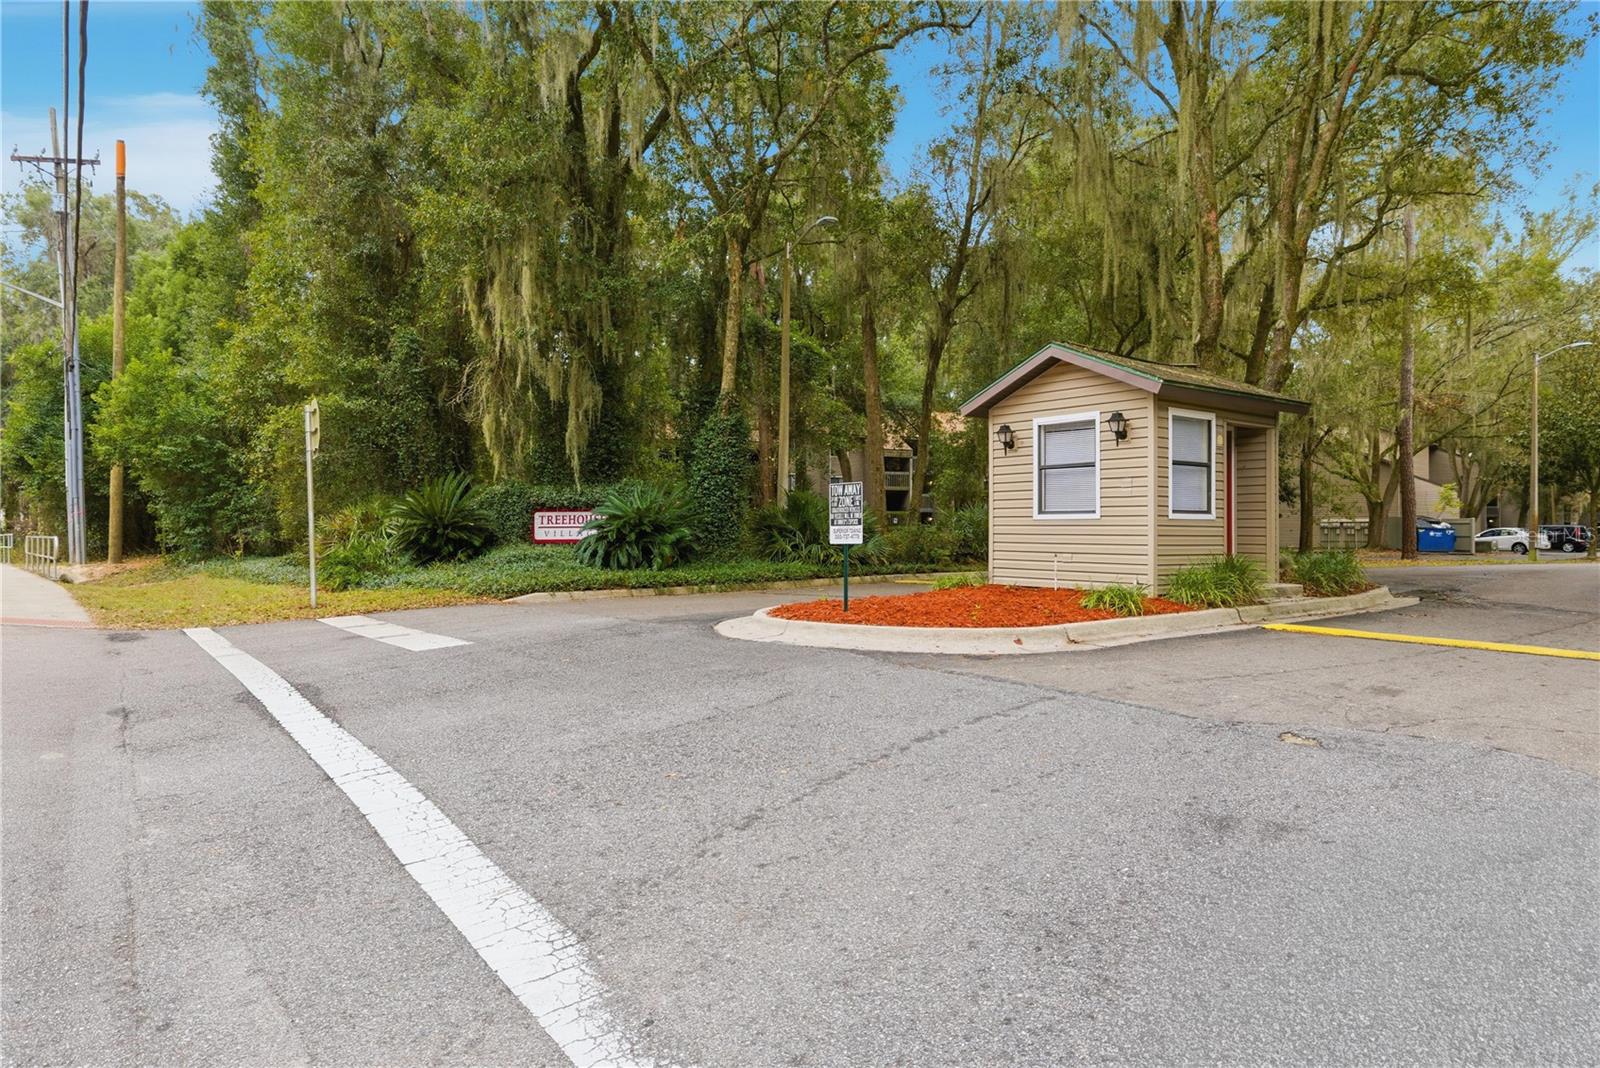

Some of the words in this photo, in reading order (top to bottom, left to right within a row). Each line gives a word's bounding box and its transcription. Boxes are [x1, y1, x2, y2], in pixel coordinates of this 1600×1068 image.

[831, 485, 843, 497] TOW
[844, 484, 861, 496] AWAY
[838, 496, 854, 508] ZONE
[538, 514, 608, 525] TREEHOU
